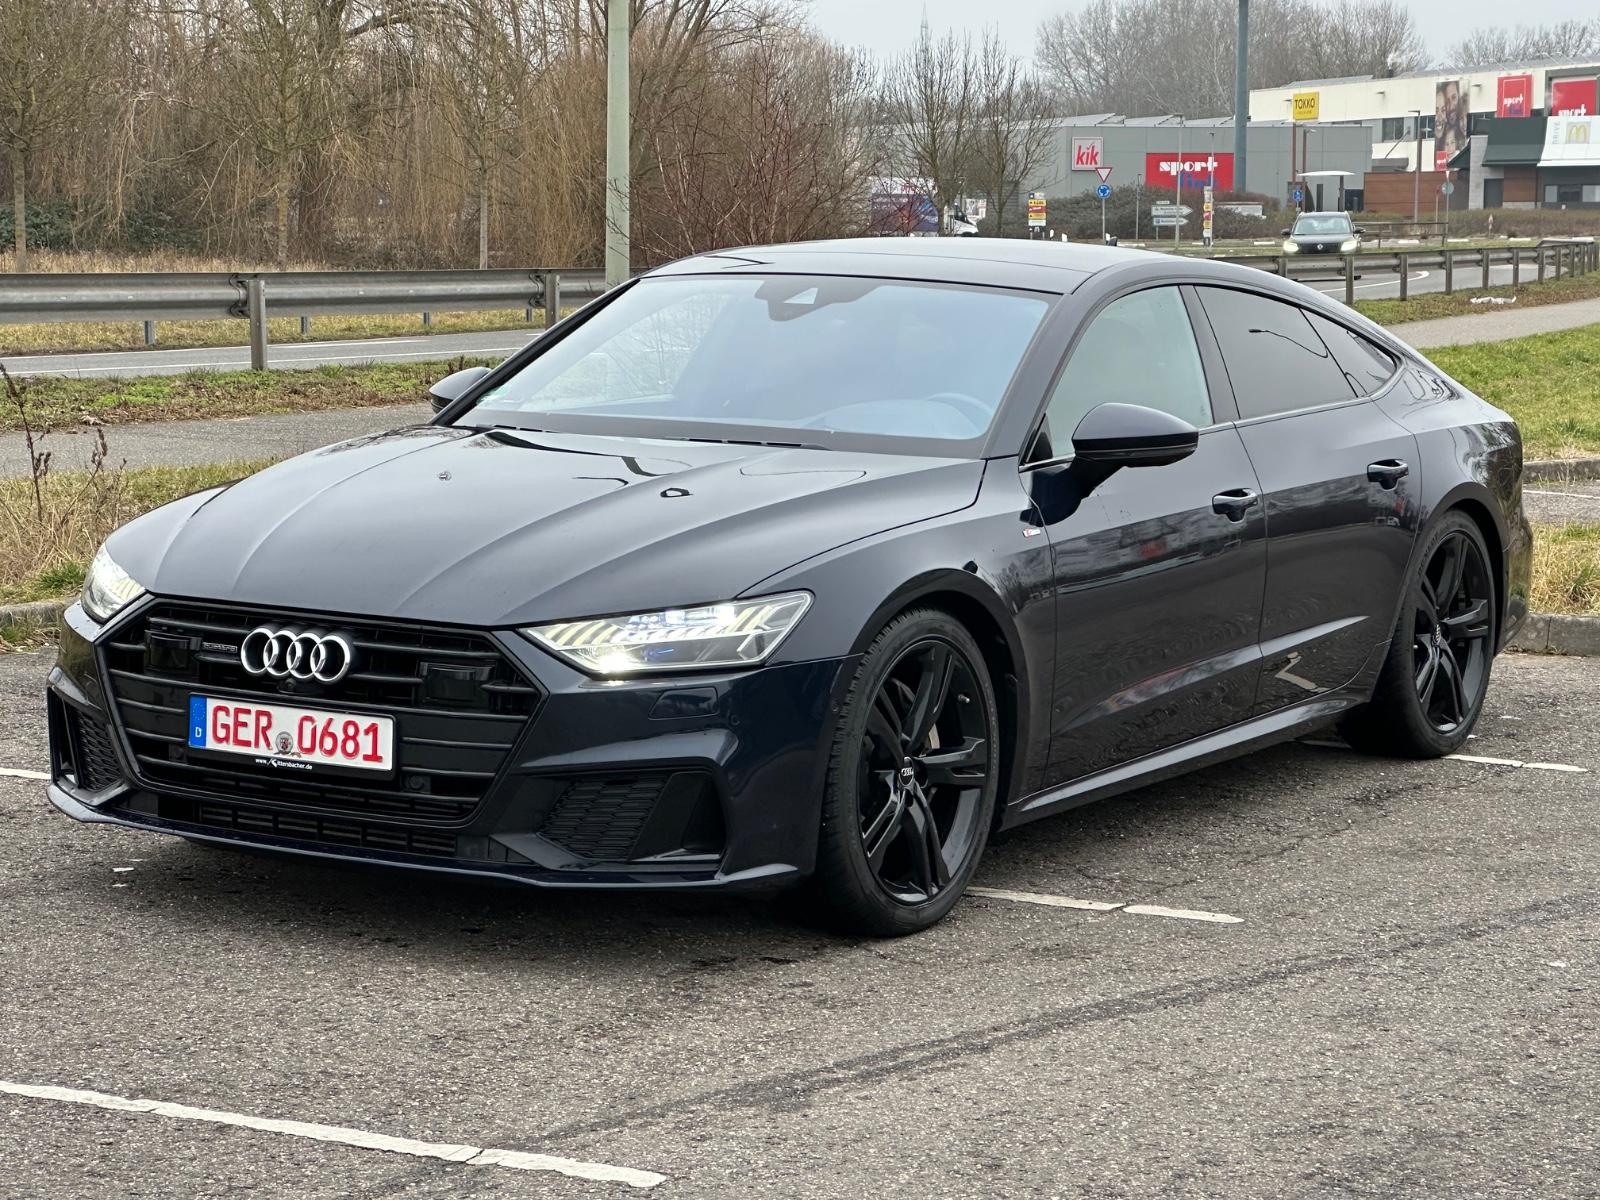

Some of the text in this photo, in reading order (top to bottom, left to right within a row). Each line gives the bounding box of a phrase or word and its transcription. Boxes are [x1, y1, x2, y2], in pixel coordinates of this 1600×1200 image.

[1295, 97, 1316, 109] TOKKO
[1159, 156, 1218, 175] sport
[195, 705, 384, 763] D GER 0681
